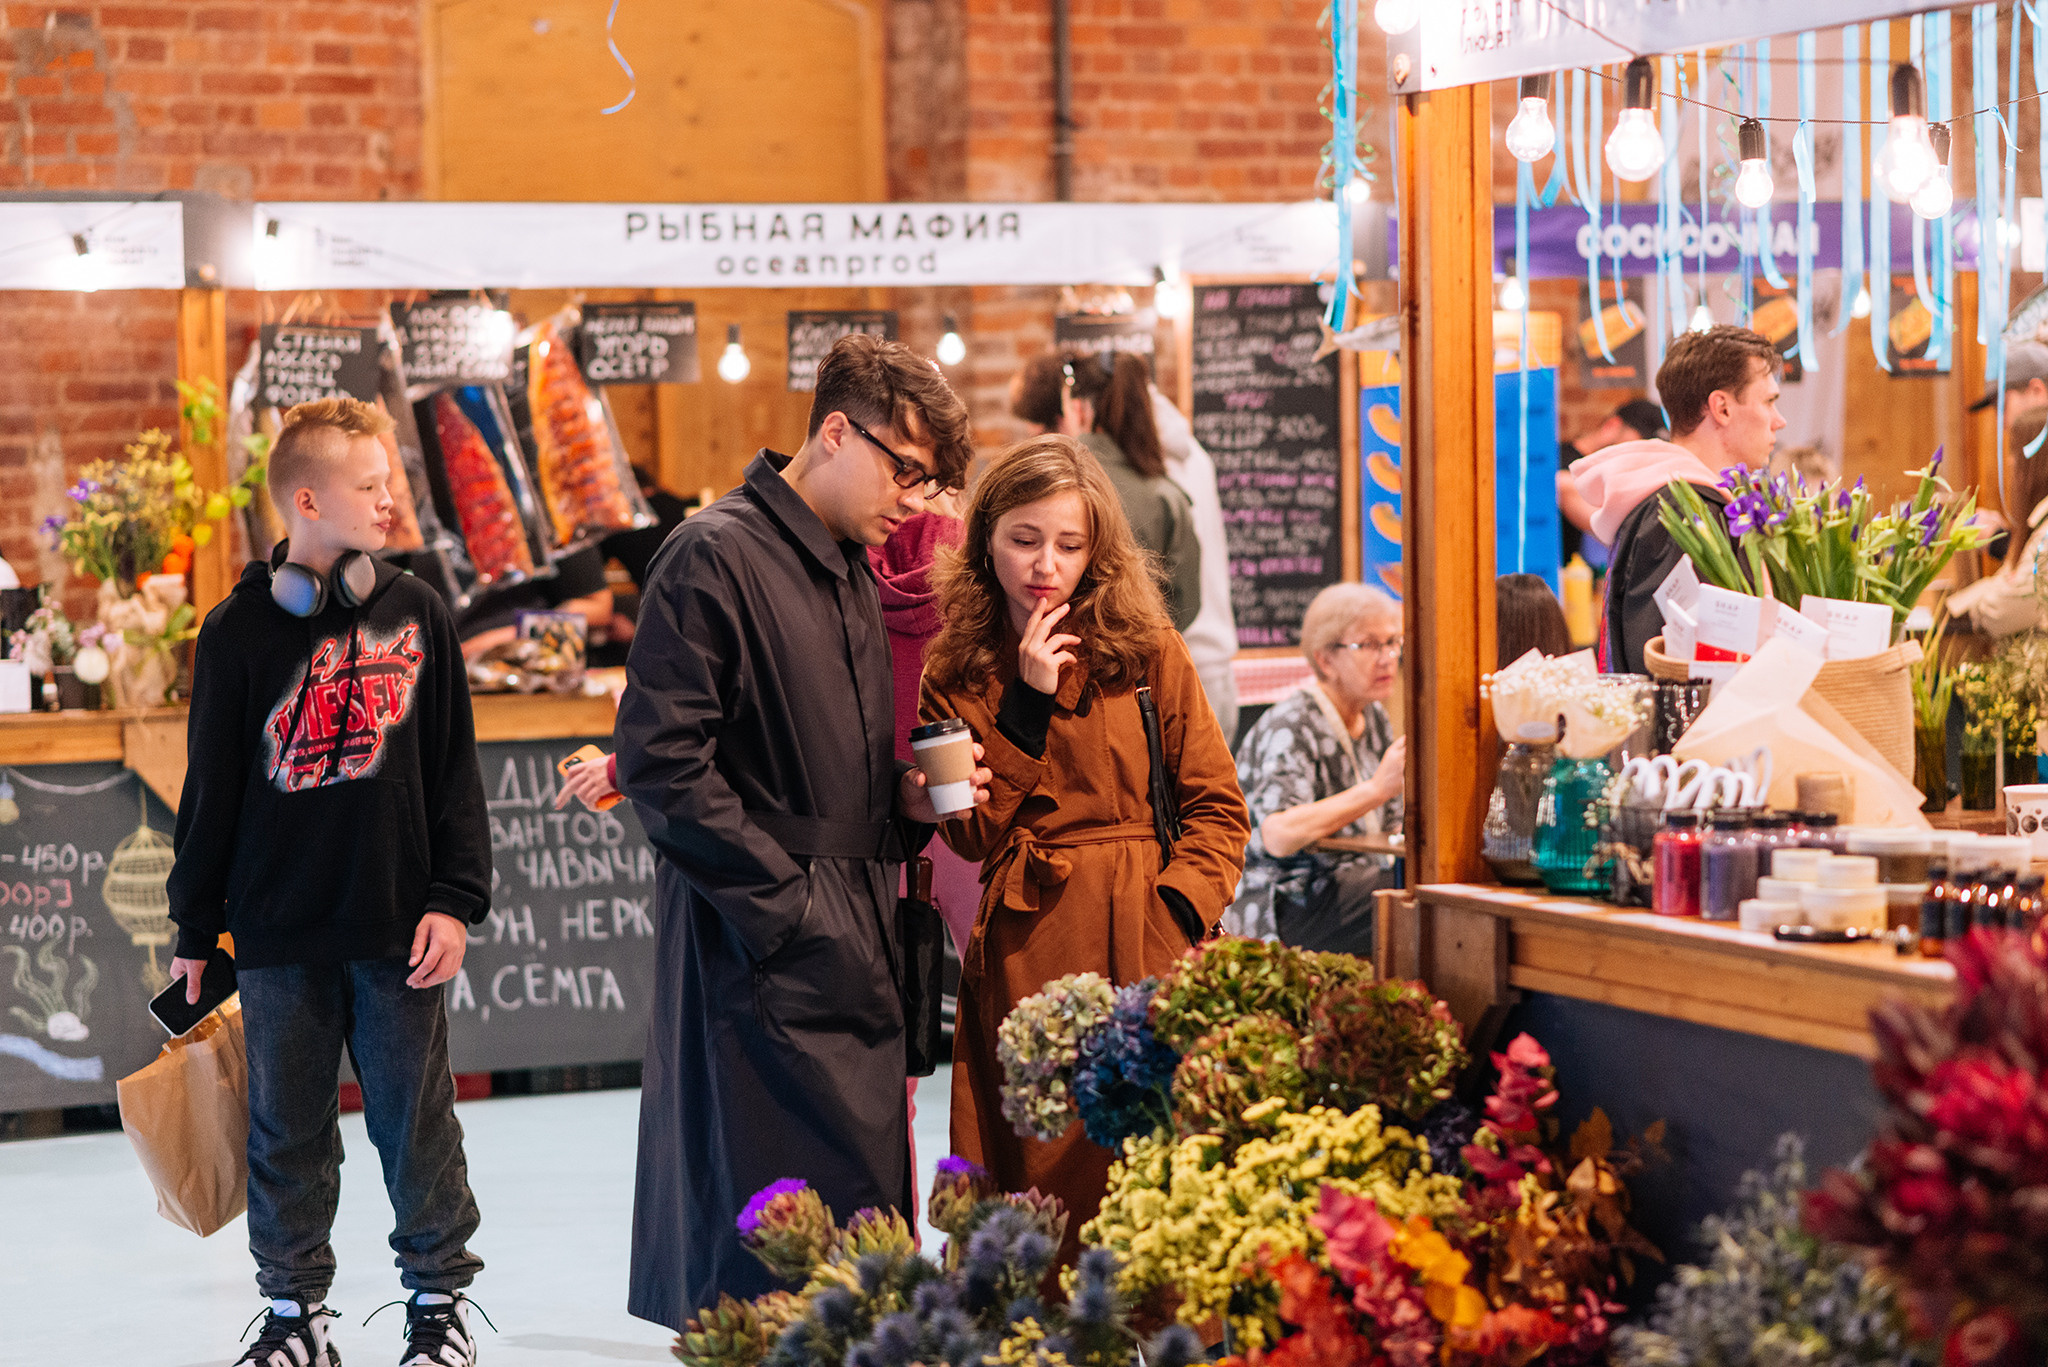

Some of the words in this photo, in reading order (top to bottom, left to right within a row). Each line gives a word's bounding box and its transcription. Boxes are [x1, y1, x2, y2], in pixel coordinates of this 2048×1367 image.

[625, 211, 825, 241] РЫБНАЯ
[850, 211, 1020, 241] МАФИЯ
[717, 249, 938, 277] oceanprod
